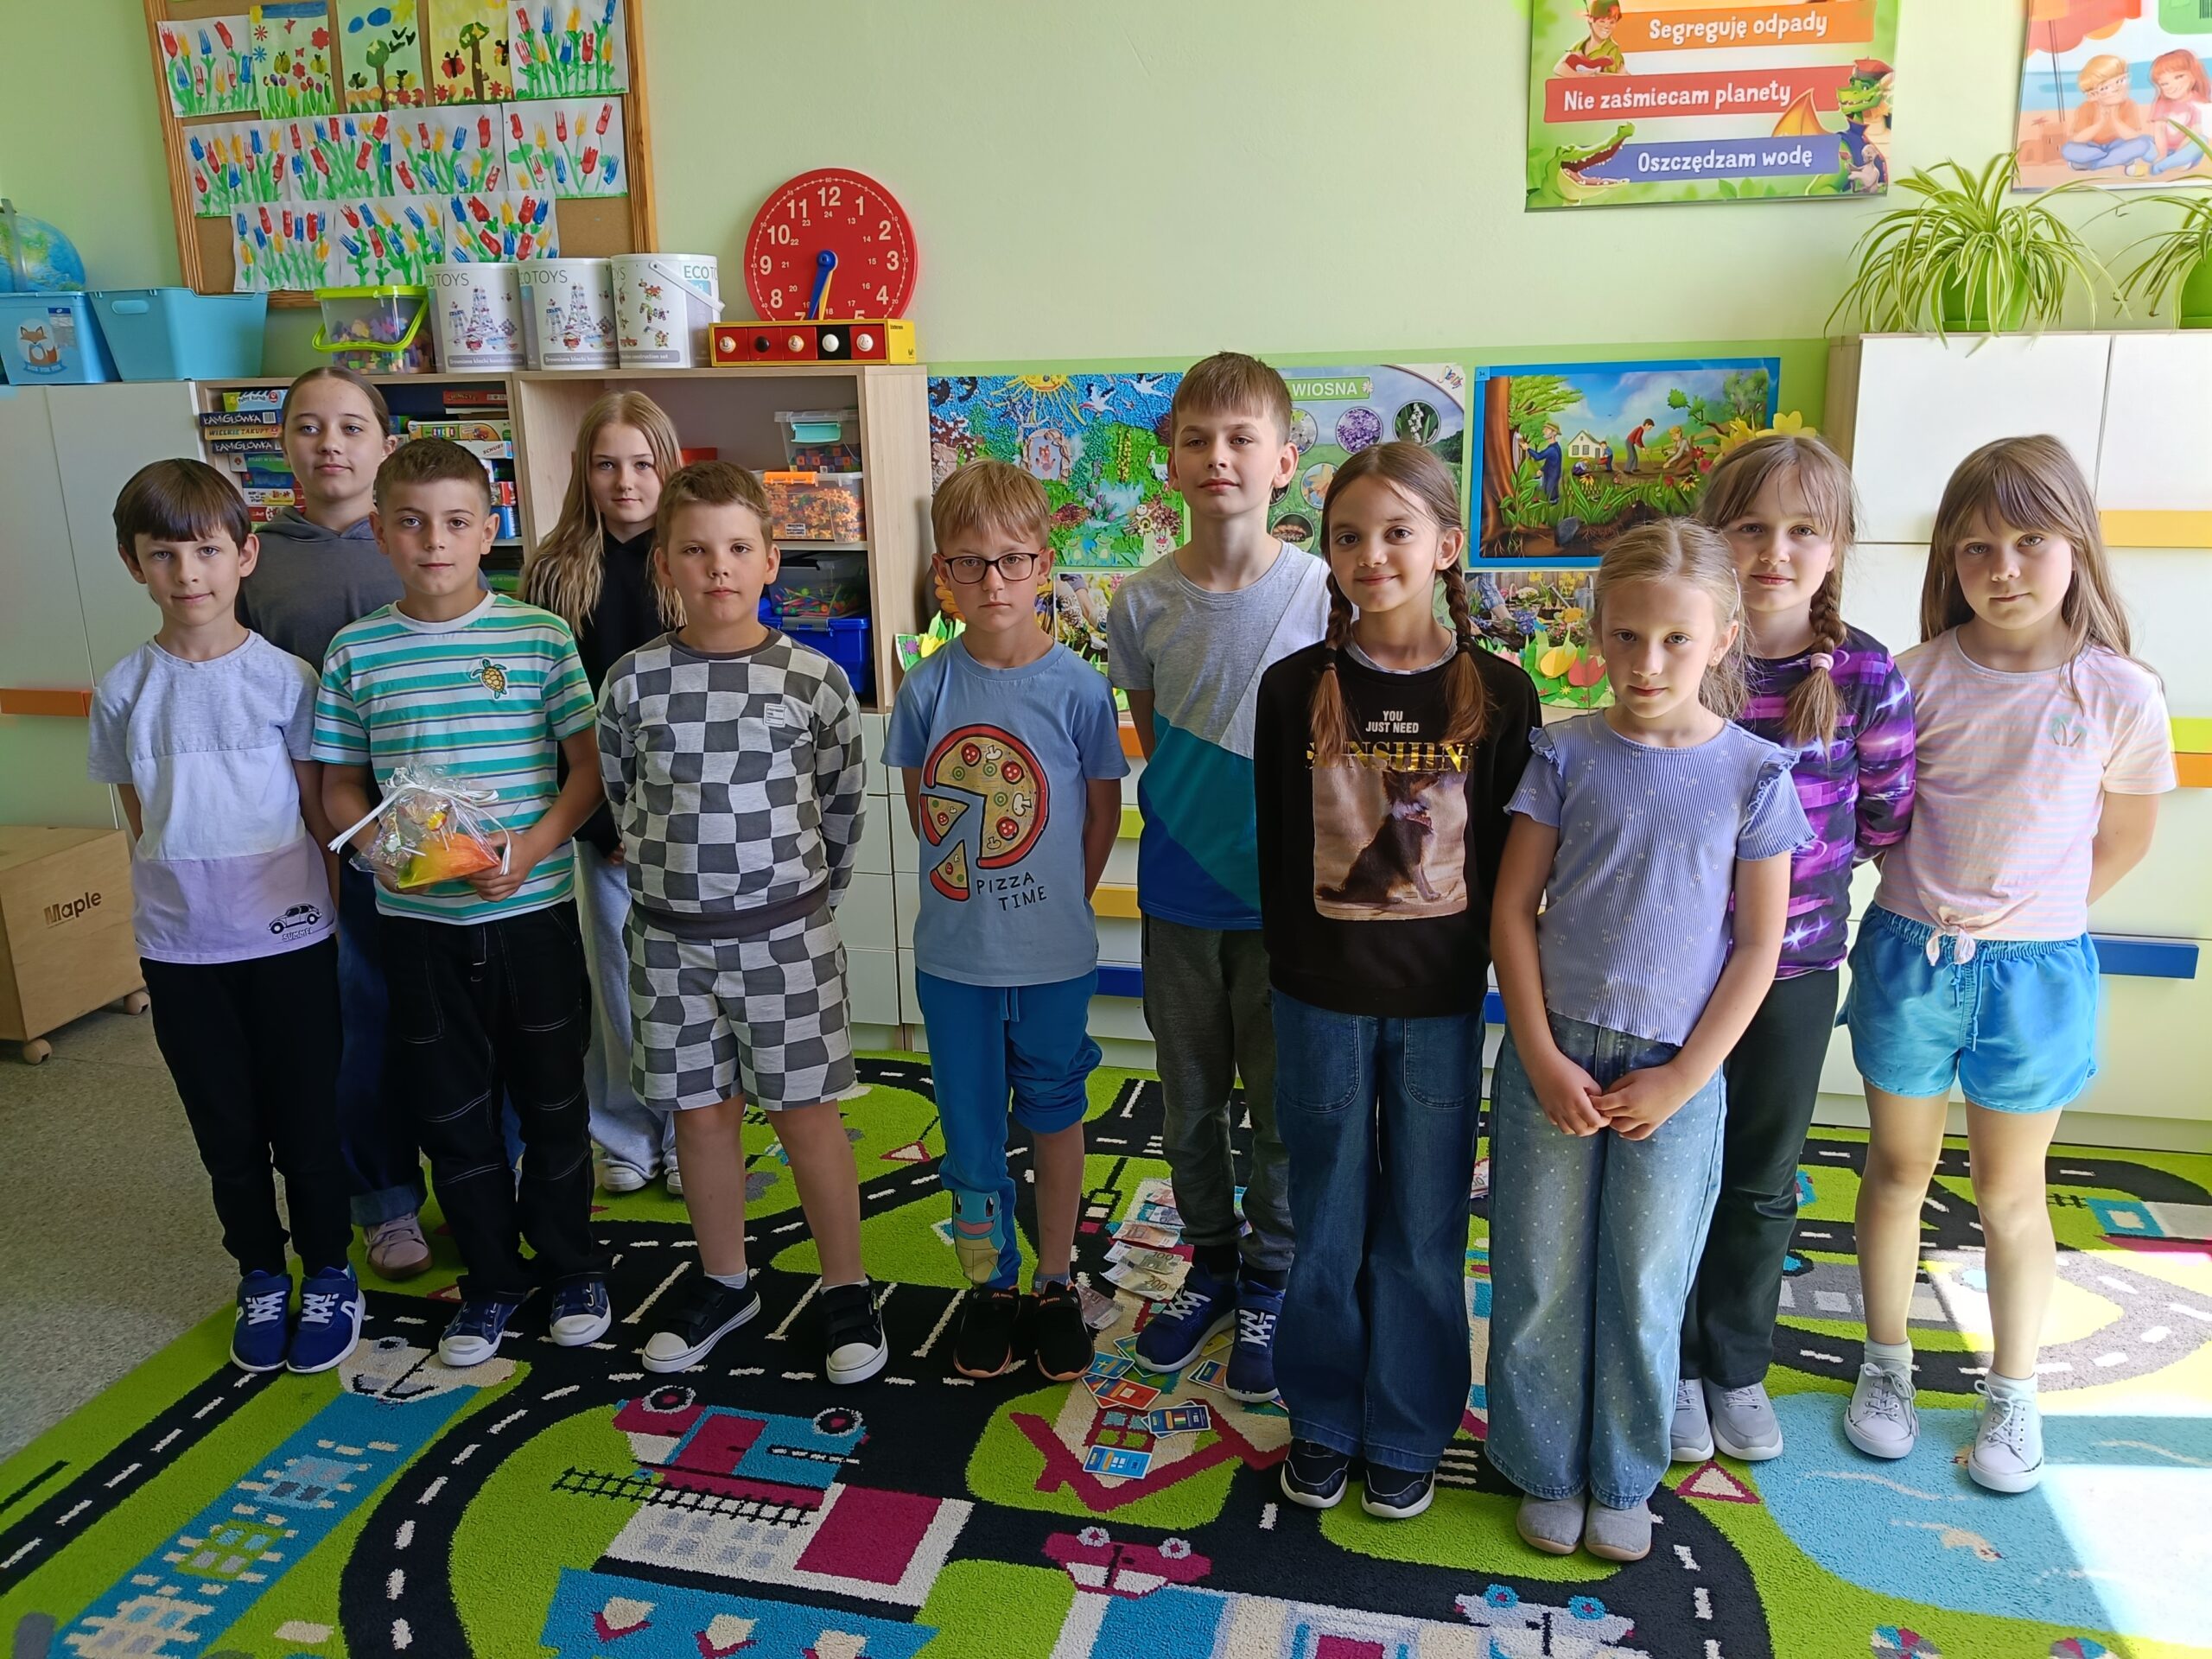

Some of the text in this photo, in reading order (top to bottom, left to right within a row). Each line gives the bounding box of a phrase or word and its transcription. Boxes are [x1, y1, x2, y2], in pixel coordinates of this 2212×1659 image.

[1649, 11, 1828, 45] Segreguję odpady
[1564, 80, 1791, 111] Nie zaśmiecam planety
[1637, 145, 1813, 175] Oszczędzam wodę
[817, 186, 841, 207] 12
[855, 195, 864, 216] 1
[786, 199, 807, 219] 11
[767, 224, 791, 245] 10
[879, 219, 892, 240] 2
[760, 255, 772, 275] 9
[887, 250, 899, 270] 3
[770, 289, 783, 308] 8
[875, 285, 889, 305] 4
[1292, 382, 1357, 397] WIOSNA
[1382, 710, 1403, 722] YOU
[1365, 721, 1420, 734] JUST NEED
[976, 871, 1035, 895] PIZZA
[43, 891, 102, 925] Maple
[998, 886, 1047, 911] TIME
[1152, 1251, 1174, 1261] 100
[1143, 1274, 1168, 1292] 200
